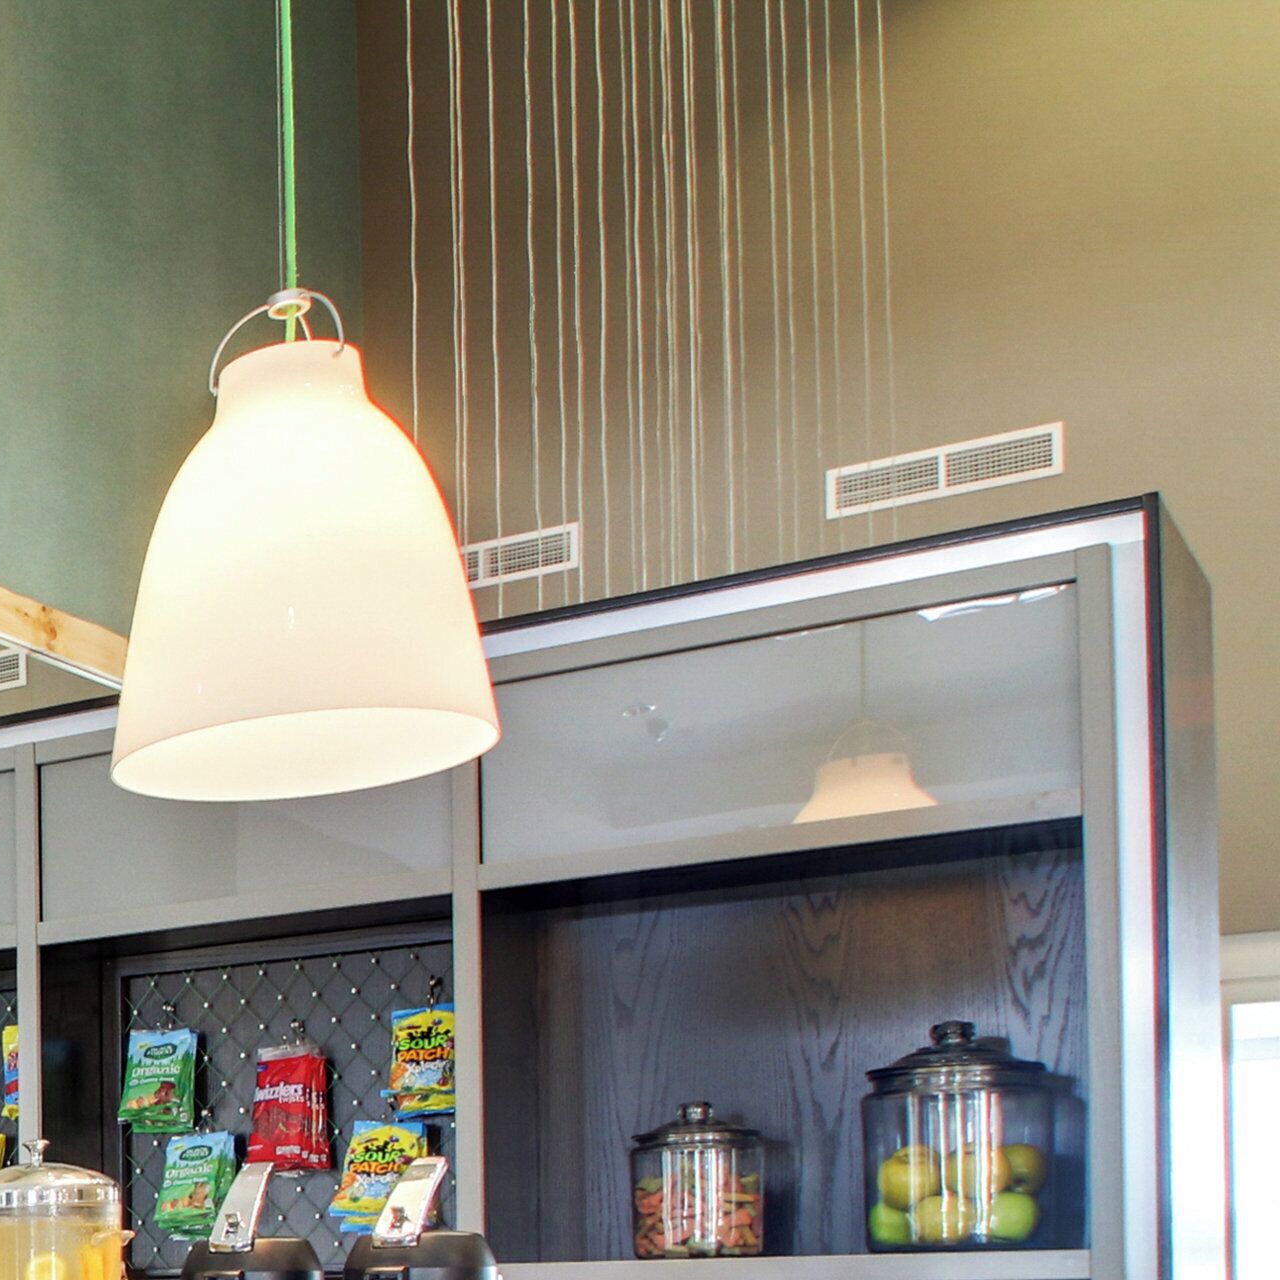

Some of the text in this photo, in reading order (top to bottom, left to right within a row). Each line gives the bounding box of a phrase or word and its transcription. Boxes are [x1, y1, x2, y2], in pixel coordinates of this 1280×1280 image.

[398, 1034, 449, 1050] SOUR
[396, 1047, 451, 1064] PATCH
[132, 1067, 180, 1078] Organic
[353, 1150, 401, 1163] SOUR
[349, 1161, 399, 1175] PATCH
